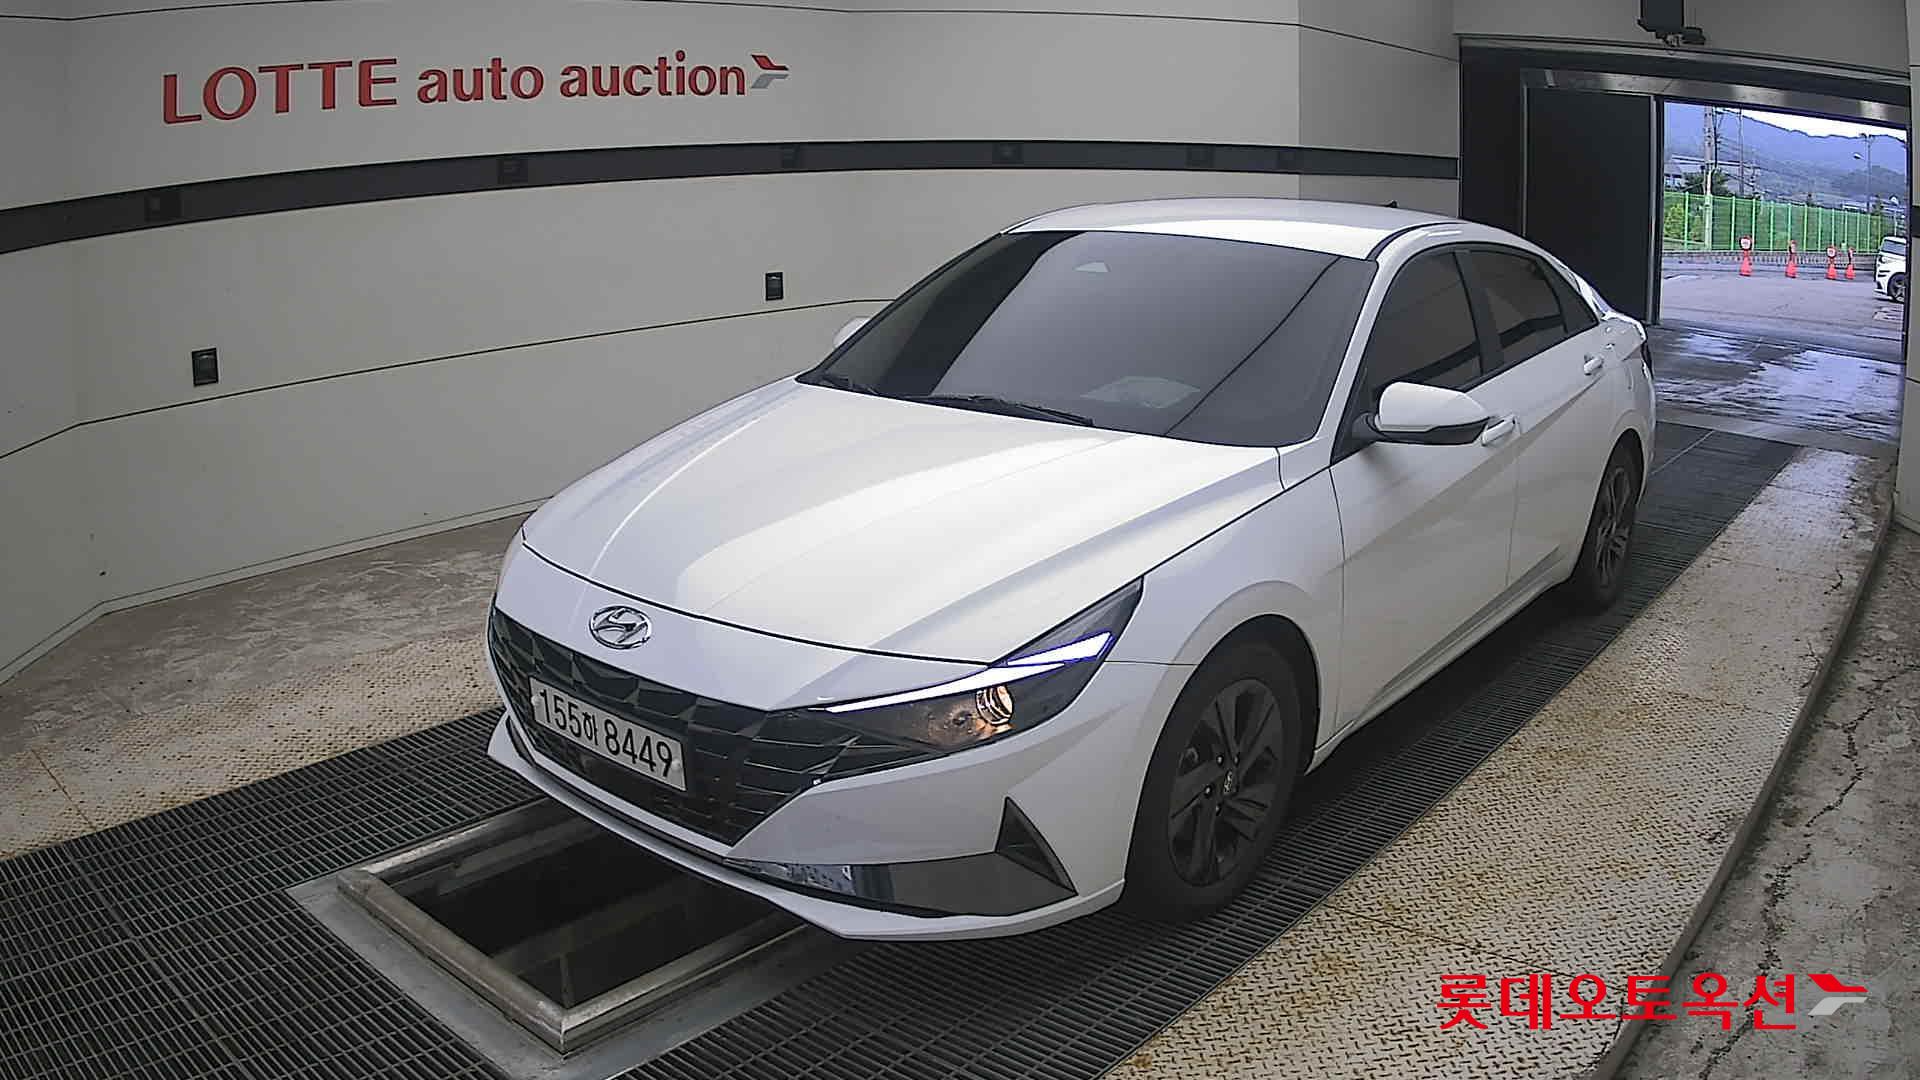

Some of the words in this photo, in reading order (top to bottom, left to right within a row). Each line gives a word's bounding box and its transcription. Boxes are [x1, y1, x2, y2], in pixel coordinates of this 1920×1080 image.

[163, 57, 398, 125] LOTTE
[417, 57, 544, 103] auto
[559, 51, 746, 98] auction
